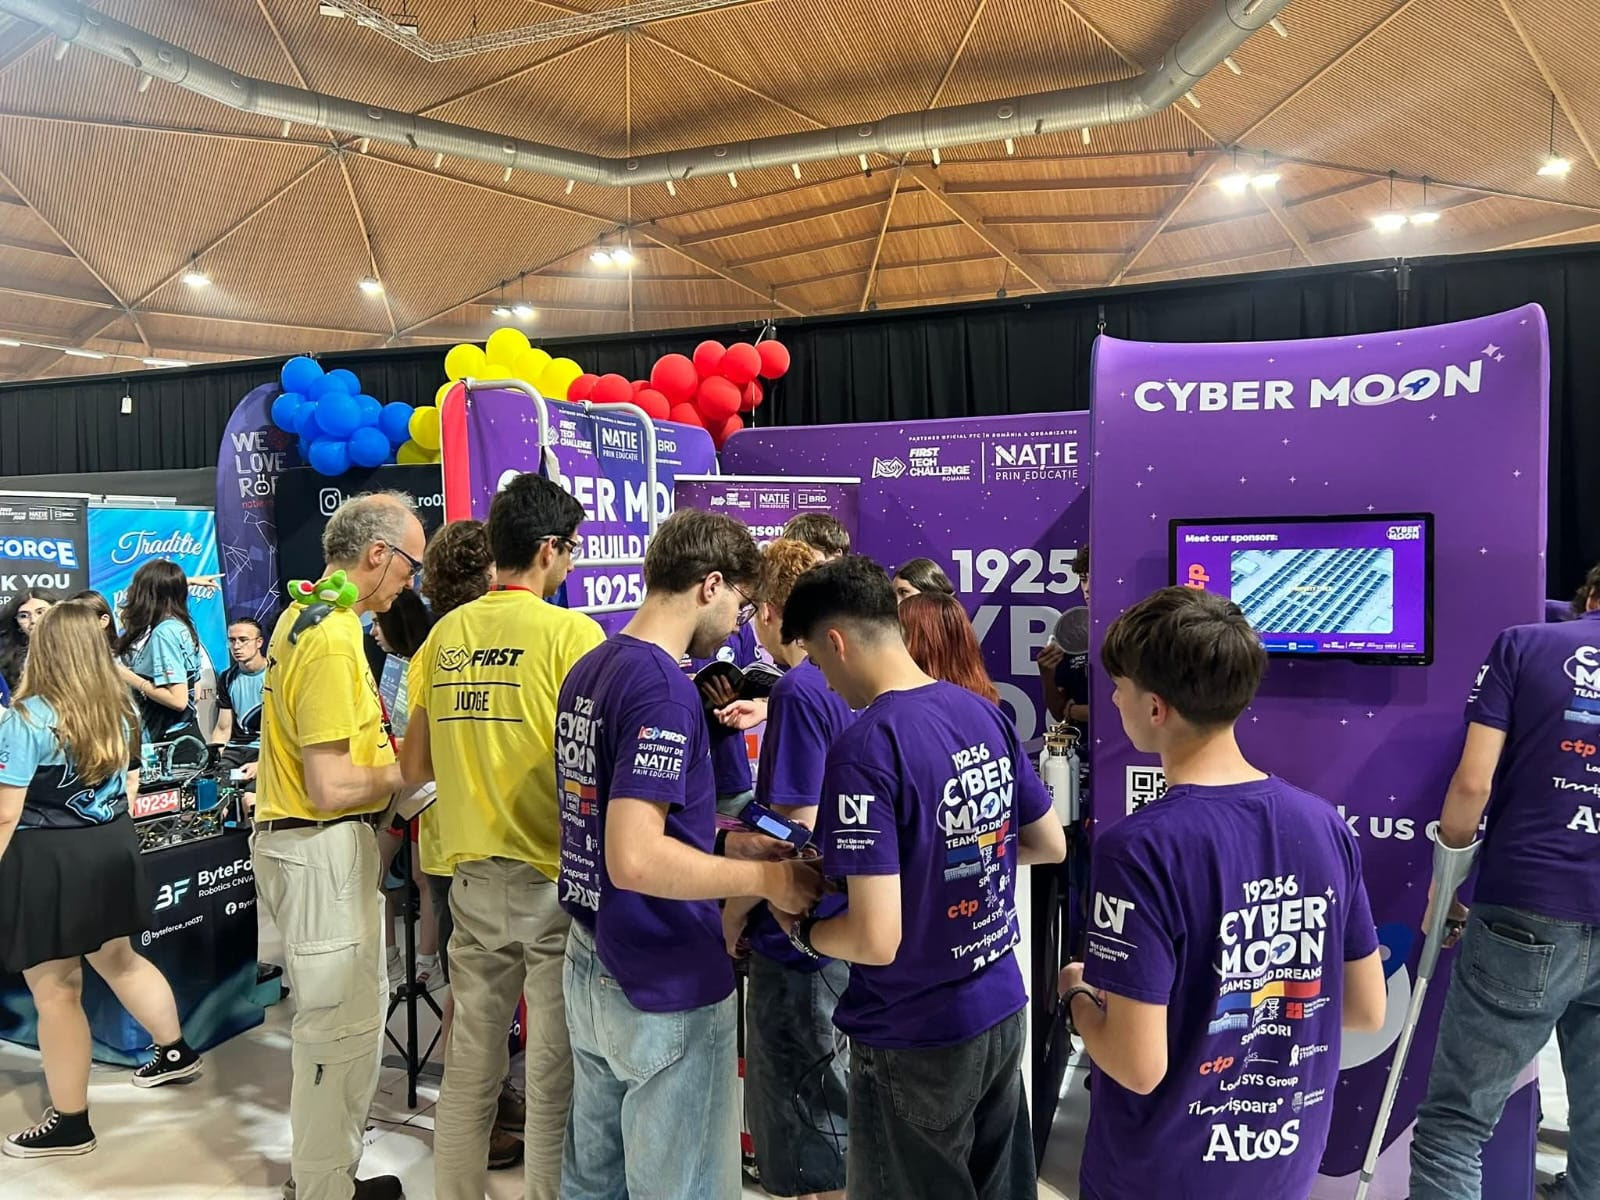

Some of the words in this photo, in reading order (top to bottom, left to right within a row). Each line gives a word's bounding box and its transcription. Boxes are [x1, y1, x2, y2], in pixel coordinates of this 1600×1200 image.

[1134, 379, 1295, 412] CYBER
[1309, 359, 1483, 408] MOON
[231, 431, 268, 452] WE
[657, 440, 677, 453] BRD
[235, 452, 288, 474] LOVE
[909, 447, 940, 458] FIRST
[910, 458, 938, 467] TECH
[910, 465, 970, 476] CHALLENGE
[995, 471, 1021, 481] PRIN
[748, 526, 784, 537] ason
[1185, 534, 1210, 543] Meet
[1231, 533, 1278, 543] sponsors:
[0, 540, 76, 566] ORCE
[588, 535, 641, 559] BUILD
[22, 574, 70, 590] YOU
[952, 549, 1080, 594] 1925
[1184, 564, 1210, 589] tp
[584, 573, 647, 608] 1925
[471, 648, 525, 667] FIRST
[660, 729, 687, 744] FIRST
[952, 743, 990, 771] 19256
[1560, 740, 1596, 757] ctp
[632, 768, 648, 776] PRIN
[944, 757, 1014, 807] CYBER
[136, 792, 178, 814] 19234
[1370, 817, 1415, 841] us
[946, 834, 978, 849] TEAMS
[198, 859, 254, 886] ByteFo
[198, 881, 232, 898] Robotics
[1242, 874, 1298, 903] 19256
[947, 899, 978, 919] ctp
[1220, 896, 1327, 945] CYBER
[1221, 930, 1325, 982] MOON
[1219, 979, 1251, 997] TEAMS
[1275, 966, 1322, 980] DREAMS
[1199, 1056, 1234, 1075] ctp
[1266, 1075, 1299, 1088] Group
[1203, 1119, 1301, 1162] Atos
